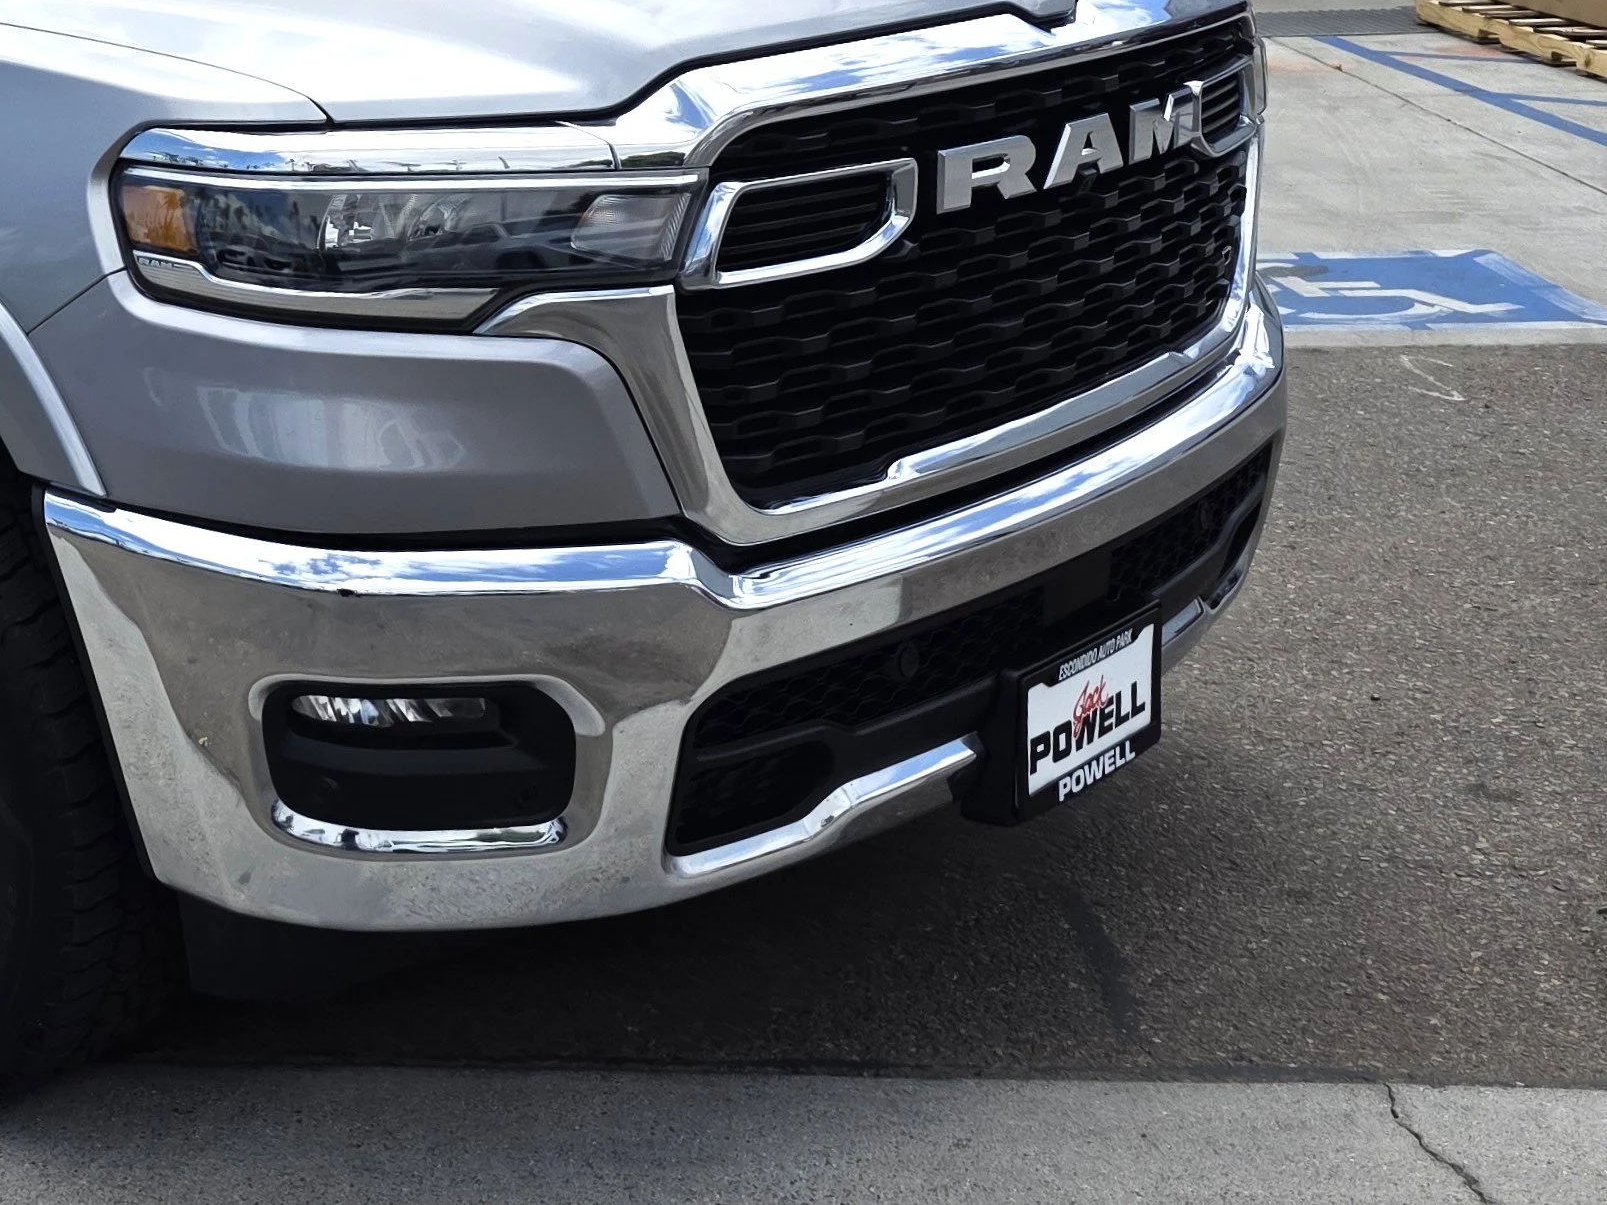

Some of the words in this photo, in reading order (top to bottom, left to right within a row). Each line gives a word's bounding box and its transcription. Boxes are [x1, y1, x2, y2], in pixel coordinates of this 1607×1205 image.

[936, 83, 1202, 214] RAM
[1058, 648, 1098, 680] ESCONDIDO
[1097, 638, 1115, 660] AUTO
[1115, 628, 1133, 651] PARK
[1029, 681, 1146, 776] POWELL
[1072, 674, 1109, 739] Jack
[1058, 740, 1136, 802] POWELL
